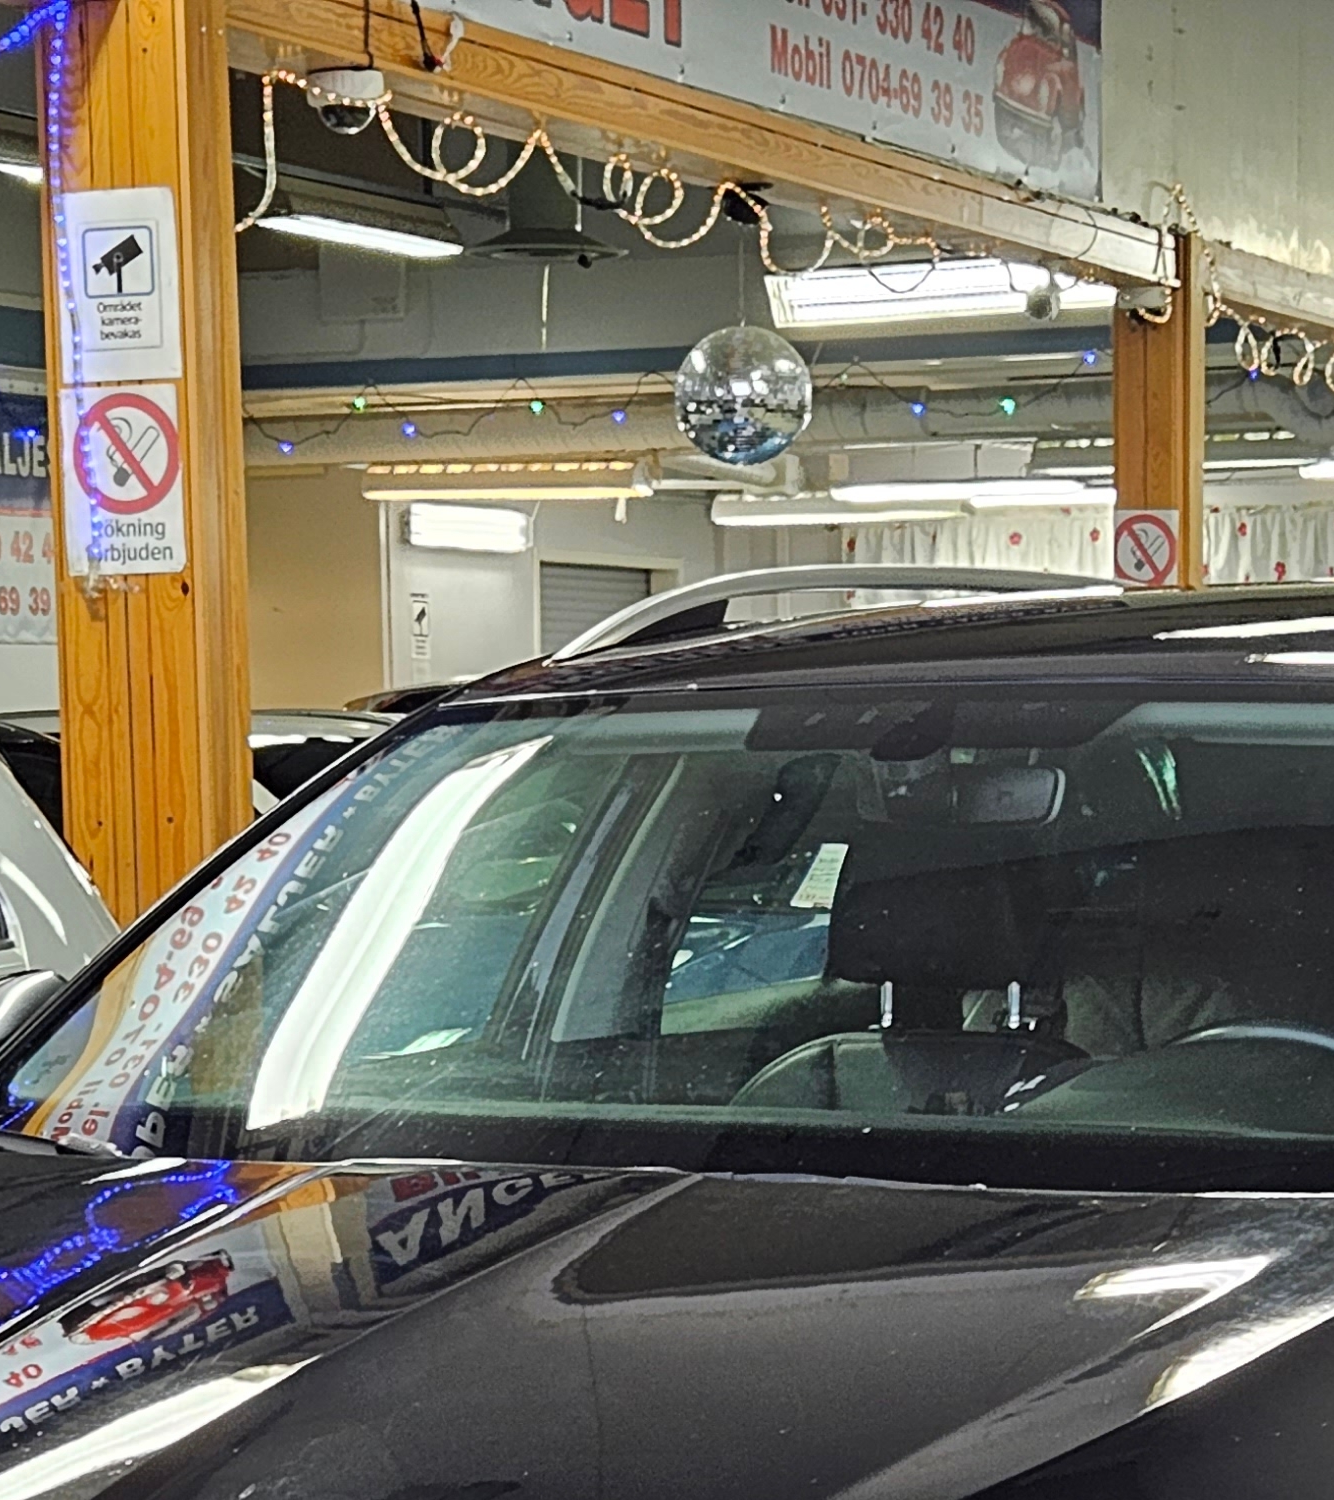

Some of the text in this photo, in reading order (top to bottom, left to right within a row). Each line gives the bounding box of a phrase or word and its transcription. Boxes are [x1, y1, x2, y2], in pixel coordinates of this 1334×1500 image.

[876, 0, 913, 43] 330
[921, 1, 945, 56] 42
[952, 13, 976, 66] 40
[769, 23, 985, 138] Mobil 0704-69 39 35
[96, 301, 143, 314] Området
[100, 315, 143, 326] kamera-
[100, 328, 143, 341] bevakas
[94, 517, 166, 541] ökning
[10, 530, 35, 564] 42
[41, 531, 54, 565] 4
[86, 543, 174, 566] rbjuden
[28, 586, 52, 617] 39
